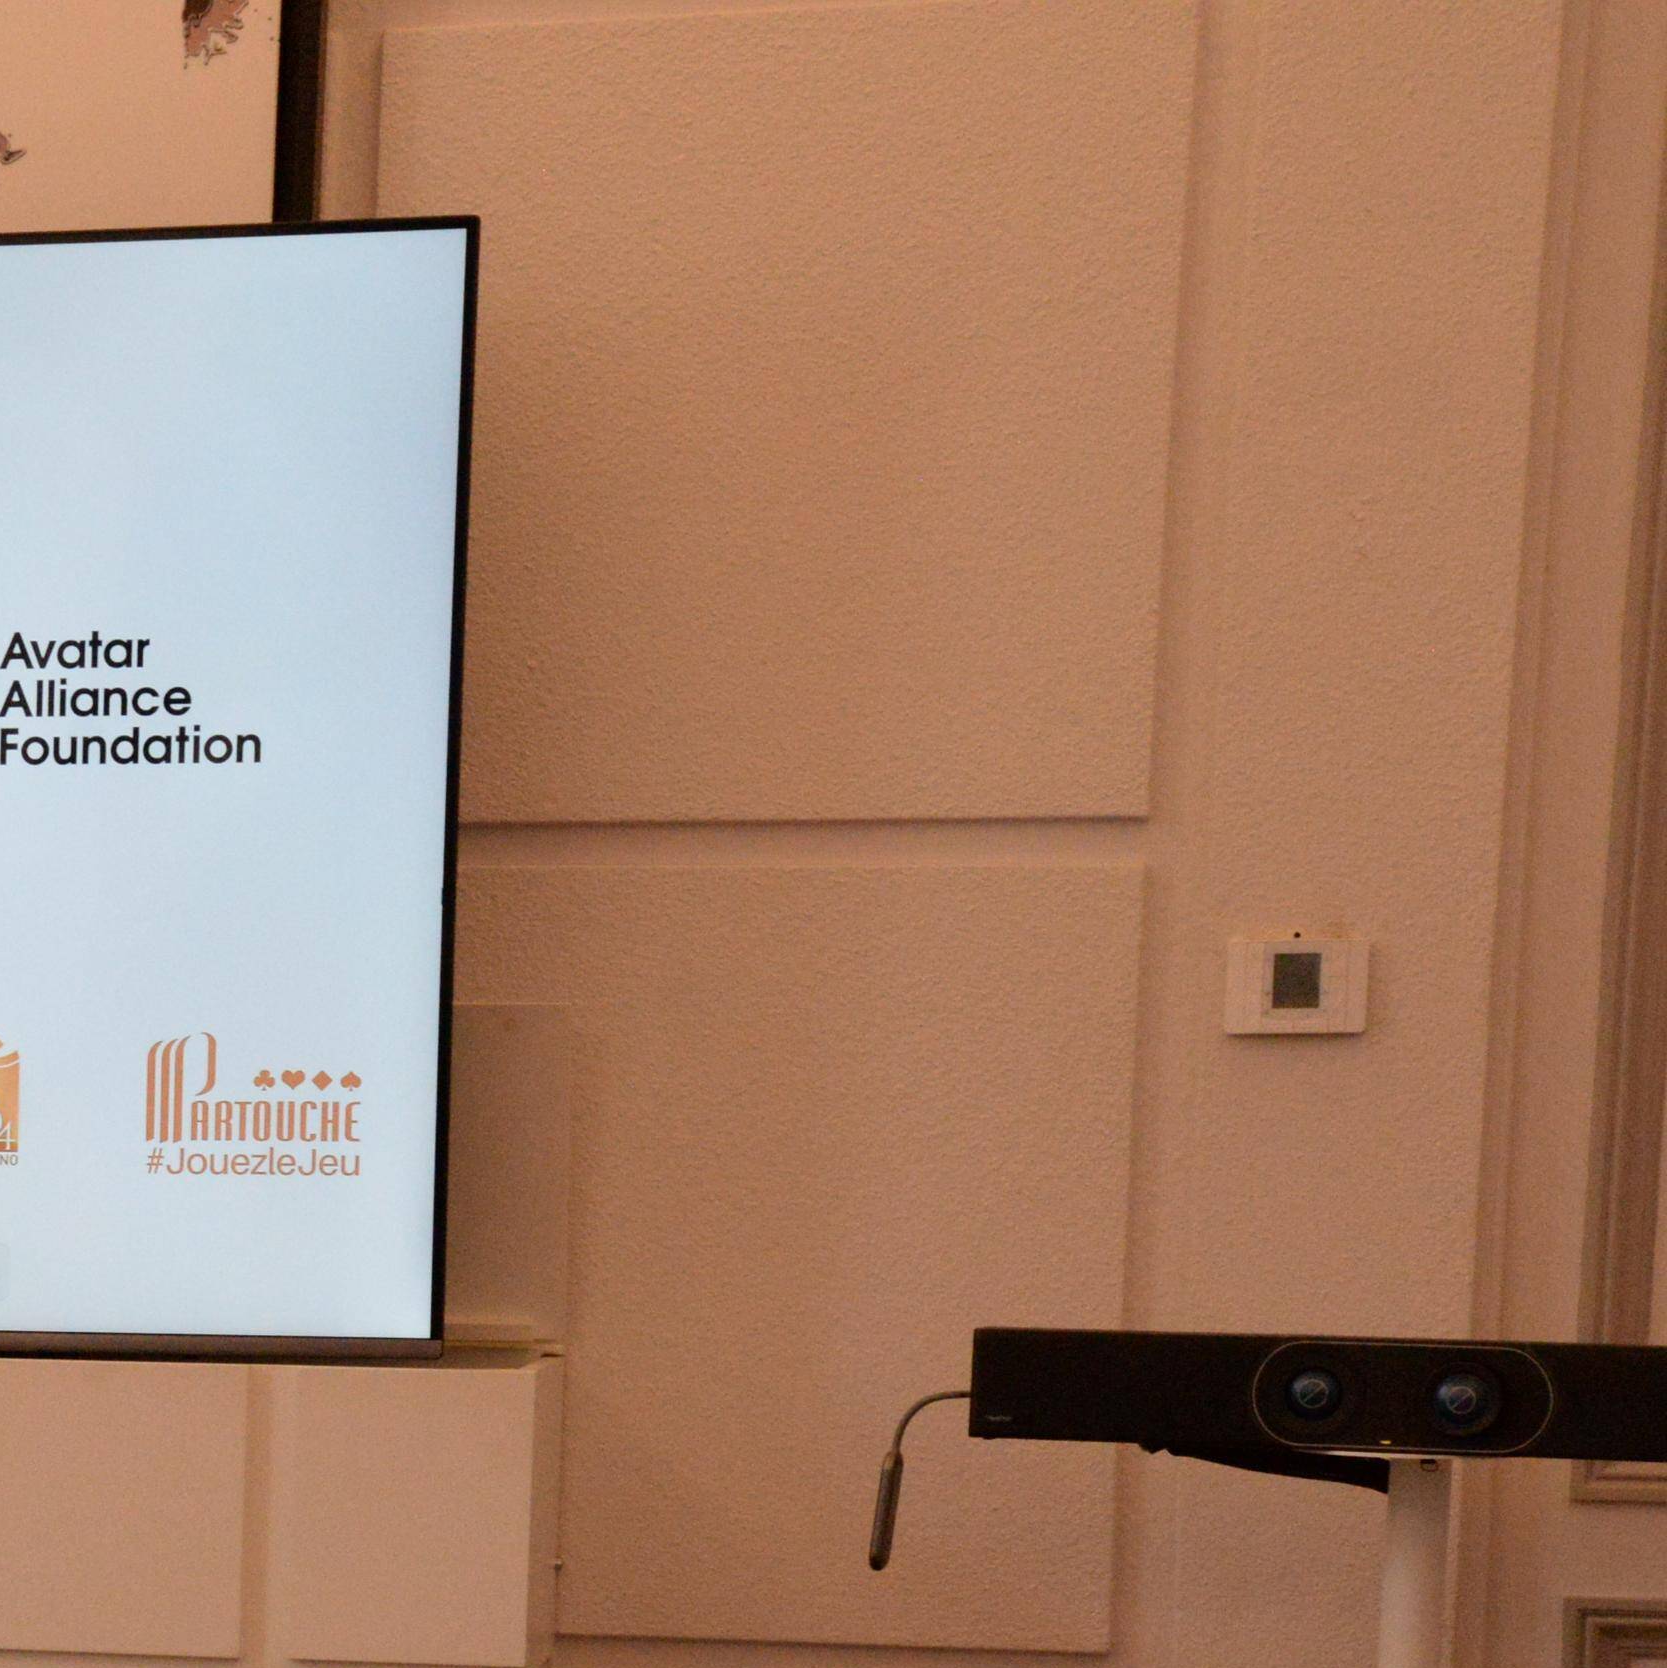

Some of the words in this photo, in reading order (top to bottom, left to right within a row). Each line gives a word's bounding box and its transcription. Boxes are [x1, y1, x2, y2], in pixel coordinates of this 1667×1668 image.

[0, 630, 151, 670] Avatar
[0, 678, 192, 717] Alliance
[0, 724, 262, 766] Foundation
[145, 1032, 362, 1143] PARTOUCHE
[147, 1147, 361, 1176] #JouezleJeu
